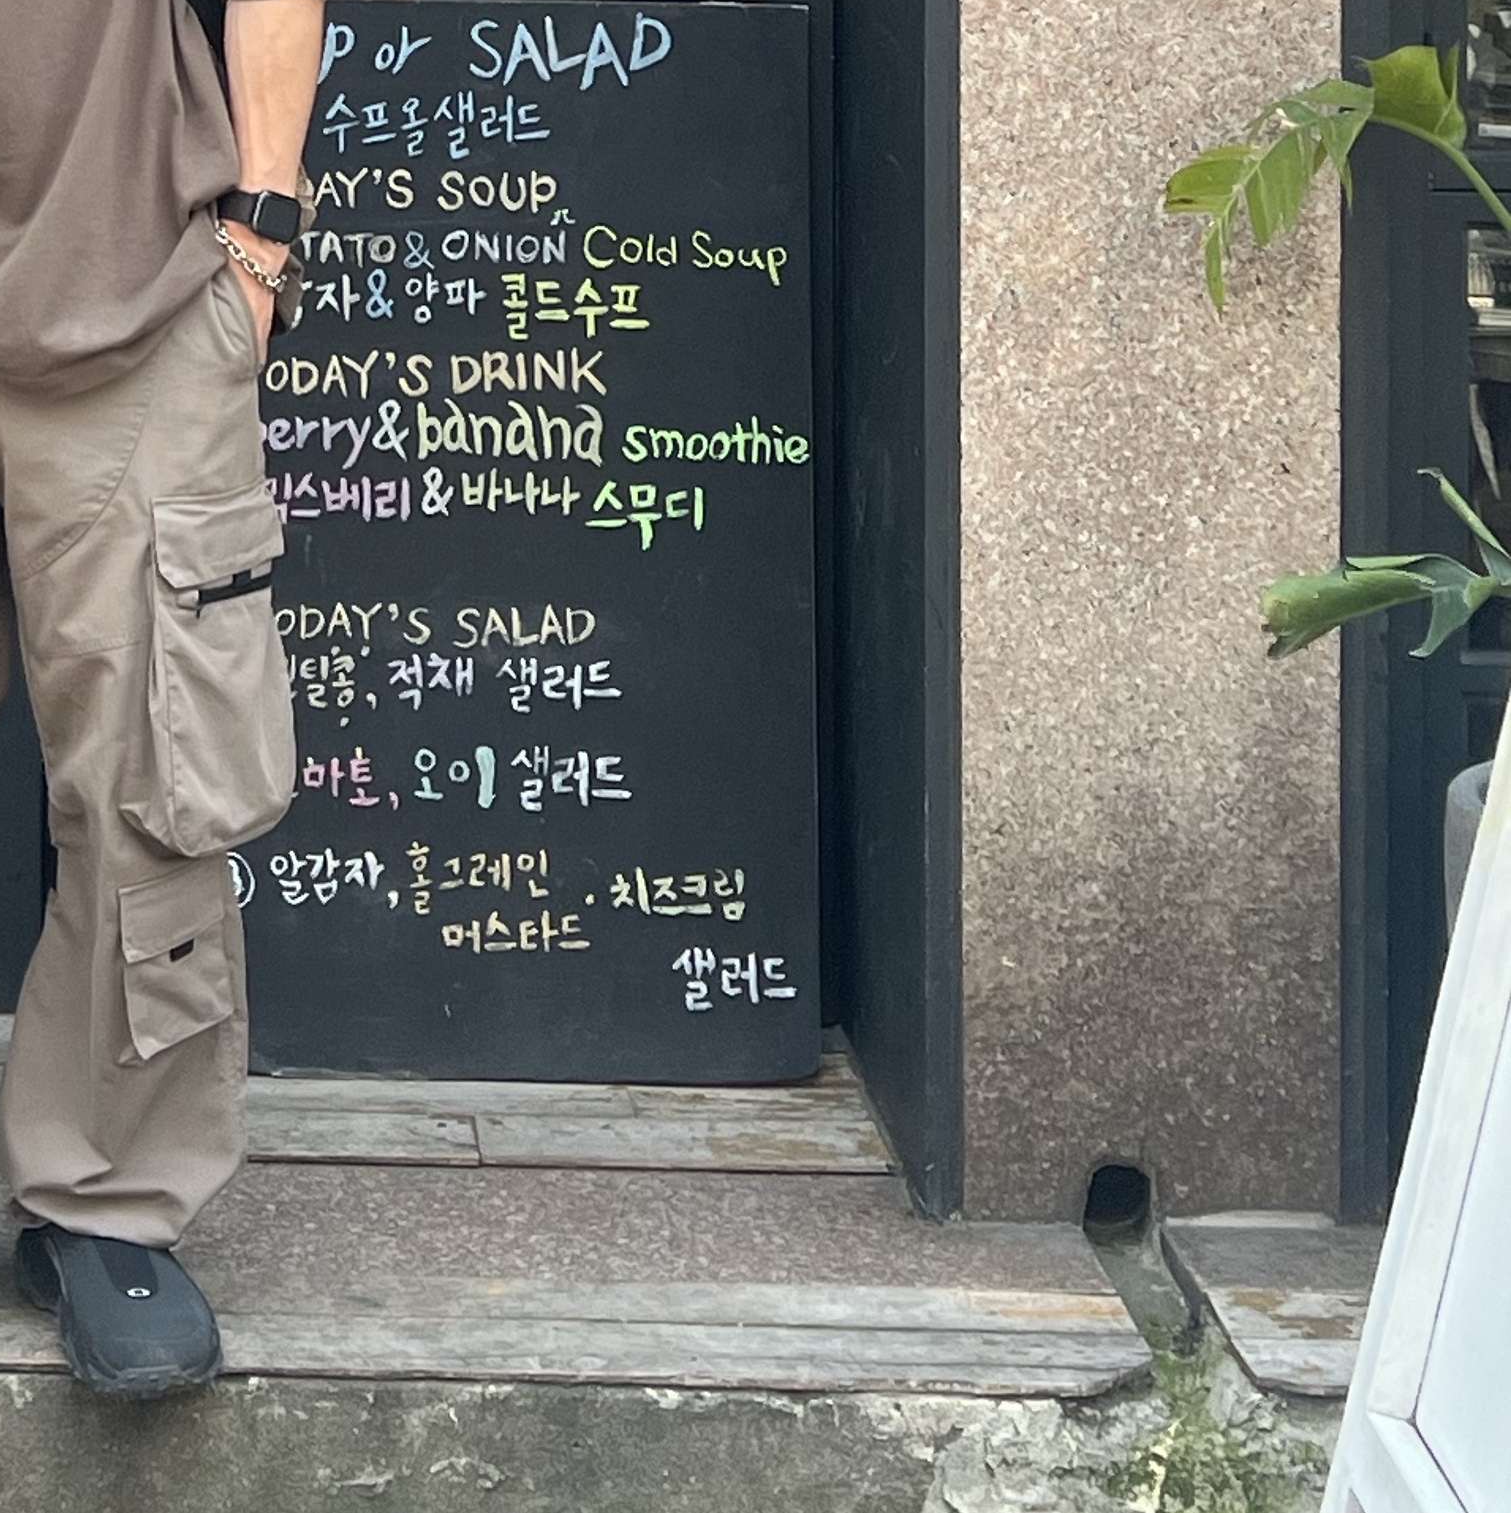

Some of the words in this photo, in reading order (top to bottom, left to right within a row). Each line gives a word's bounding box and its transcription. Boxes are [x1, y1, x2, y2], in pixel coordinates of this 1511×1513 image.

[468, 11, 672, 91] SALAD
[314, 167, 415, 210] AY'S
[437, 170, 558, 214] SOUP
[300, 230, 397, 269] TATO
[441, 229, 567, 266] ONION
[583, 224, 679, 269] Cold
[691, 231, 788, 287] Soup
[405, 271, 488, 325] 양파
[500, 272, 651, 341] 콜드수프
[265, 349, 434, 400] ODAY'S
[451, 347, 608, 397] DRINK
[262, 414, 373, 471] erry
[416, 397, 605, 468] banana
[621, 416, 812, 465] smoothie
[421, 465, 456, 518] &
[461, 467, 582, 517] 바나나
[585, 478, 706, 552] 스무디
[274, 600, 432, 647] ODAY'S
[452, 605, 597, 648] SALAD
[495, 656, 623, 714] 샐러드
[290, 746, 400, 811] 마토,
[413, 745, 496, 809] 오이
[510, 745, 634, 812] 샐러드
[406, 841, 550, 915] 홀그레인
[609, 866, 747, 922] 치즈크림
[441, 910, 592, 953] 머스타드
